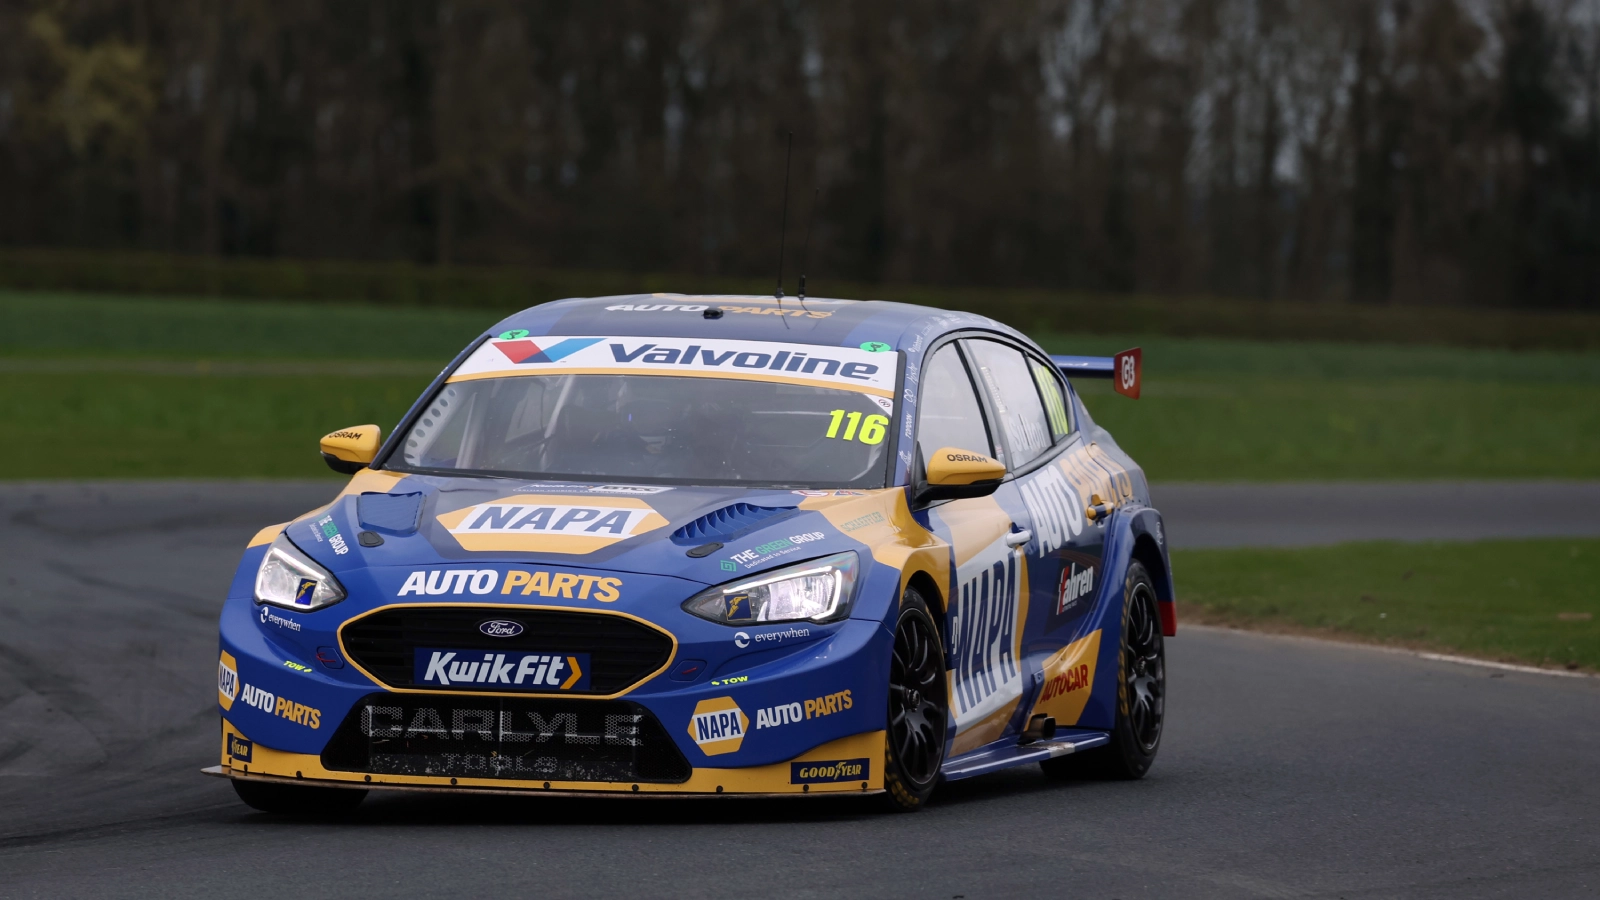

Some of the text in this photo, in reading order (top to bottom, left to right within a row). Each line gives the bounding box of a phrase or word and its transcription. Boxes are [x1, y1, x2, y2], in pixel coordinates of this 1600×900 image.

[604, 304, 834, 318] AUTO PARTS
[609, 343, 879, 381] Valvoline
[825, 409, 889, 445] 116
[947, 454, 988, 463] OSRAM
[468, 506, 632, 535] NAPA
[1021, 465, 1083, 559] AUTO
[329, 533, 349, 555] GROUP
[730, 531, 825, 564] THE GREEN GROUP
[397, 569, 623, 602] AUTO PARTS
[1057, 562, 1093, 615] fahren
[268, 614, 301, 632] everywhen
[486, 621, 515, 635] Ford
[755, 628, 810, 643] everywhen
[955, 551, 1017, 714] NAPA
[219, 664, 235, 698] NAPA
[283, 660, 305, 671] TOW
[722, 676, 749, 685] TOW
[1040, 664, 1089, 704] AUTOCAR
[241, 683, 321, 729] AUTO PARTS
[756, 689, 853, 729] AUTO PARTS
[360, 705, 643, 746] CARLYLE
[696, 711, 741, 741] NAPA
[799, 762, 862, 779] GOODYEAR
